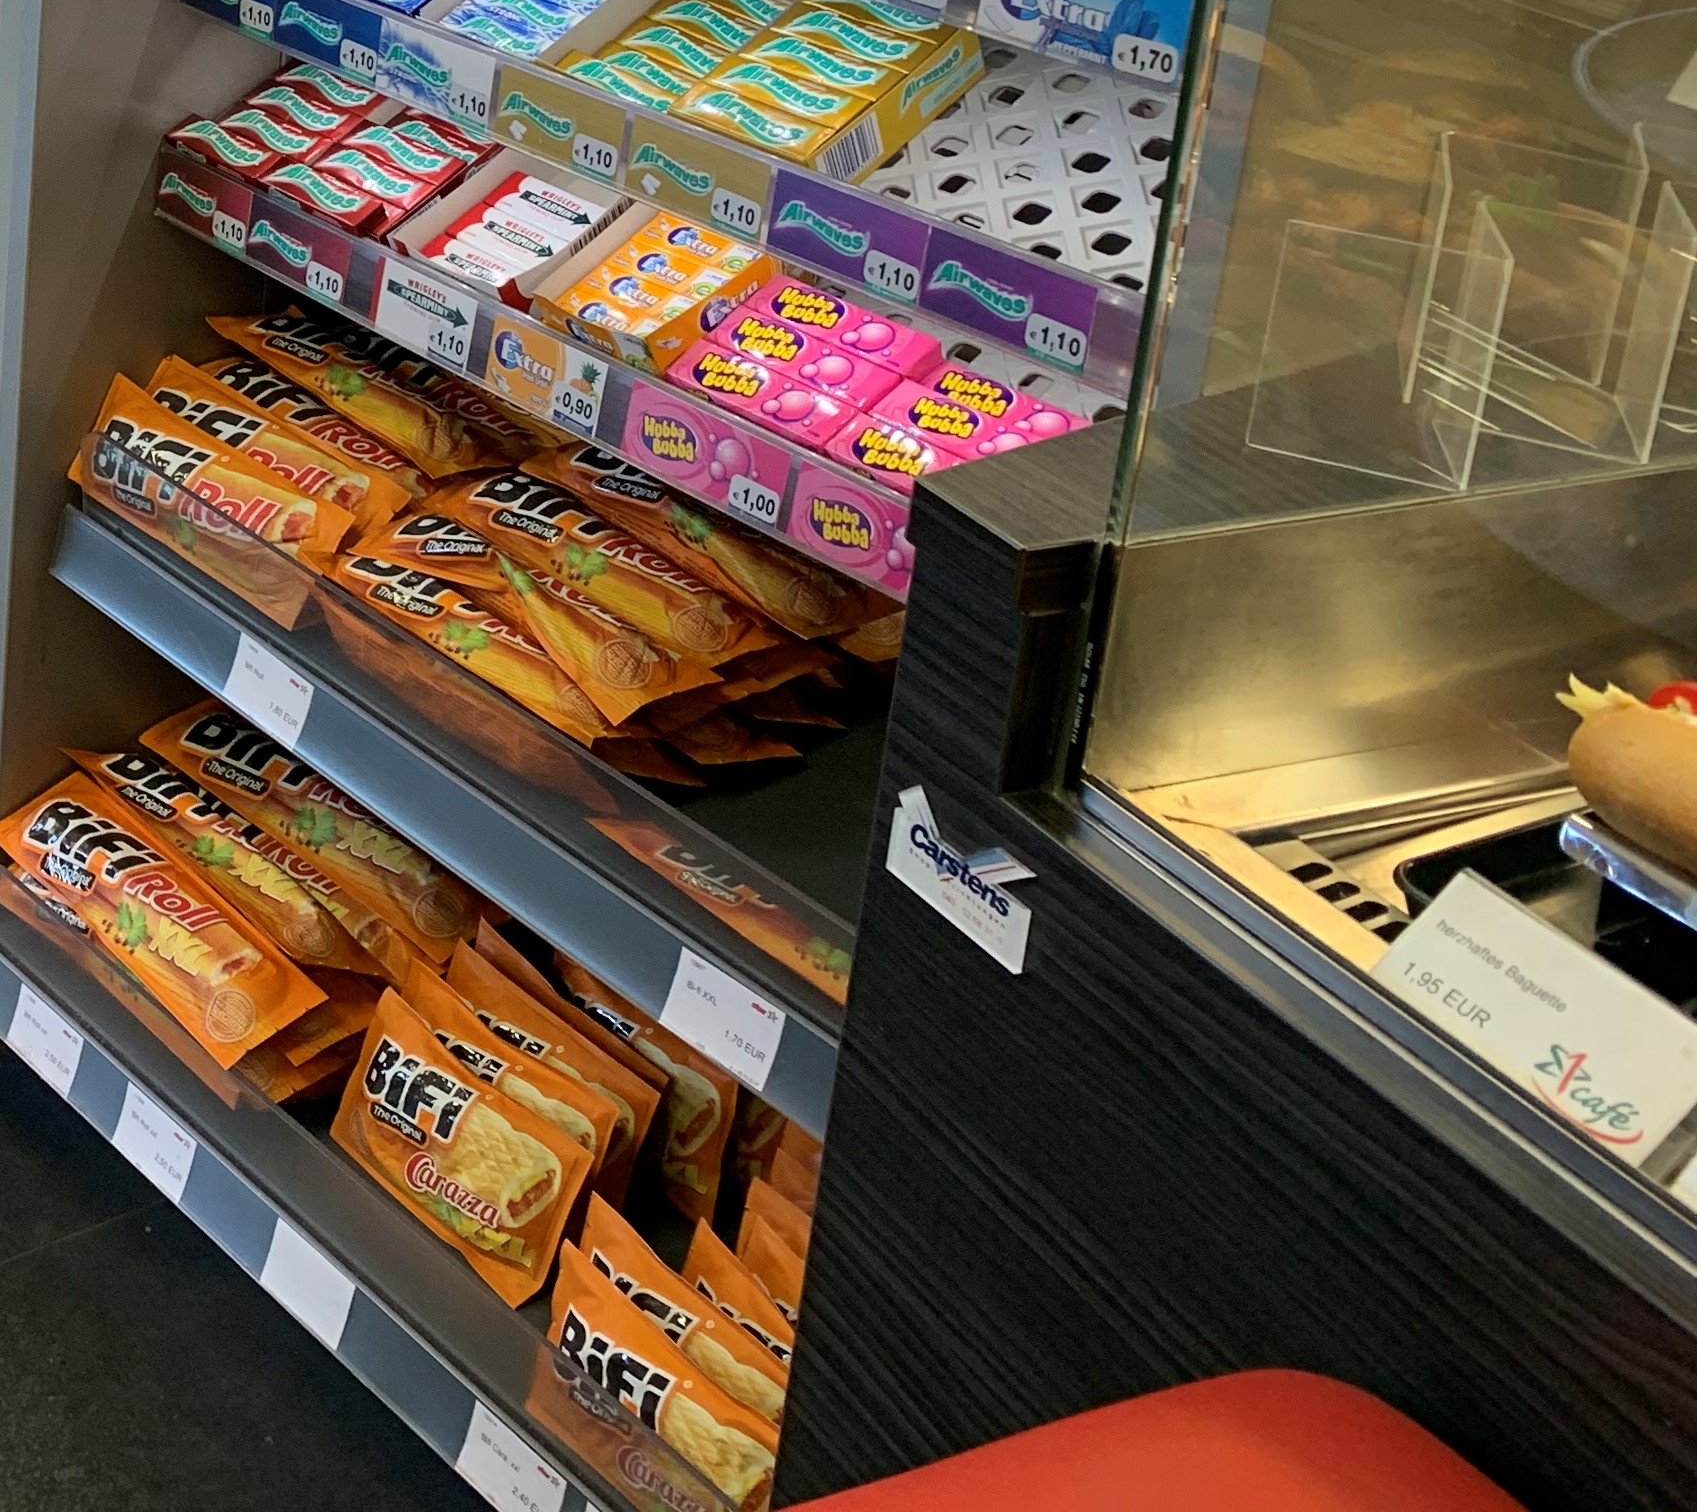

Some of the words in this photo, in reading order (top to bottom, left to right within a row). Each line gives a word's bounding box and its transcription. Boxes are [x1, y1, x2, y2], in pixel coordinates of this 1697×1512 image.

[282, 3, 342, 45] Airwaves
[758, 39, 876, 87] Airwaves
[503, 92, 572, 137] Airwaves
[635, 143, 711, 190] Airwaves
[162, 176, 215, 215] Airwaves
[253, 222, 309, 264] Airwaves
[780, 200, 865, 253] Airwaves
[399, 287, 454, 318] SPEARMINT
[406, 278, 448, 305] WRIGLEY'S
[777, 285, 836, 317] Hubba
[934, 261, 1027, 315] Airwaves
[782, 301, 841, 329] Bubba
[501, 339, 553, 381] Extra
[308, 419, 407, 471] Roll
[644, 415, 687, 443] Hubba
[652, 433, 696, 463] Bubba
[177, 480, 283, 540] Roll
[497, 510, 515, 525] The
[515, 513, 559, 541] Original
[283, 712, 299, 729] EUR
[206, 759, 226, 775] The
[225, 765, 268, 795] Original
[22, 797, 171, 885] BiFi
[910, 824, 1012, 918] Carstens
[124, 870, 228, 933] Roll
[148, 915, 213, 977] XXL
[1435, 918, 1505, 971] herzhaftes
[1504, 965, 1568, 1014] Baguette
[1403, 961, 1444, 996] 1,95
[1442, 986, 1493, 1030] EUR
[724, 1029, 744, 1048] 1,70
[743, 1042, 766, 1064] EUR
[363, 1034, 480, 1144] BiFi
[373, 1102, 393, 1125] The
[390, 1112, 426, 1144] Original
[167, 1164, 183, 1183] EUR
[405, 1151, 500, 1230] Carazza
